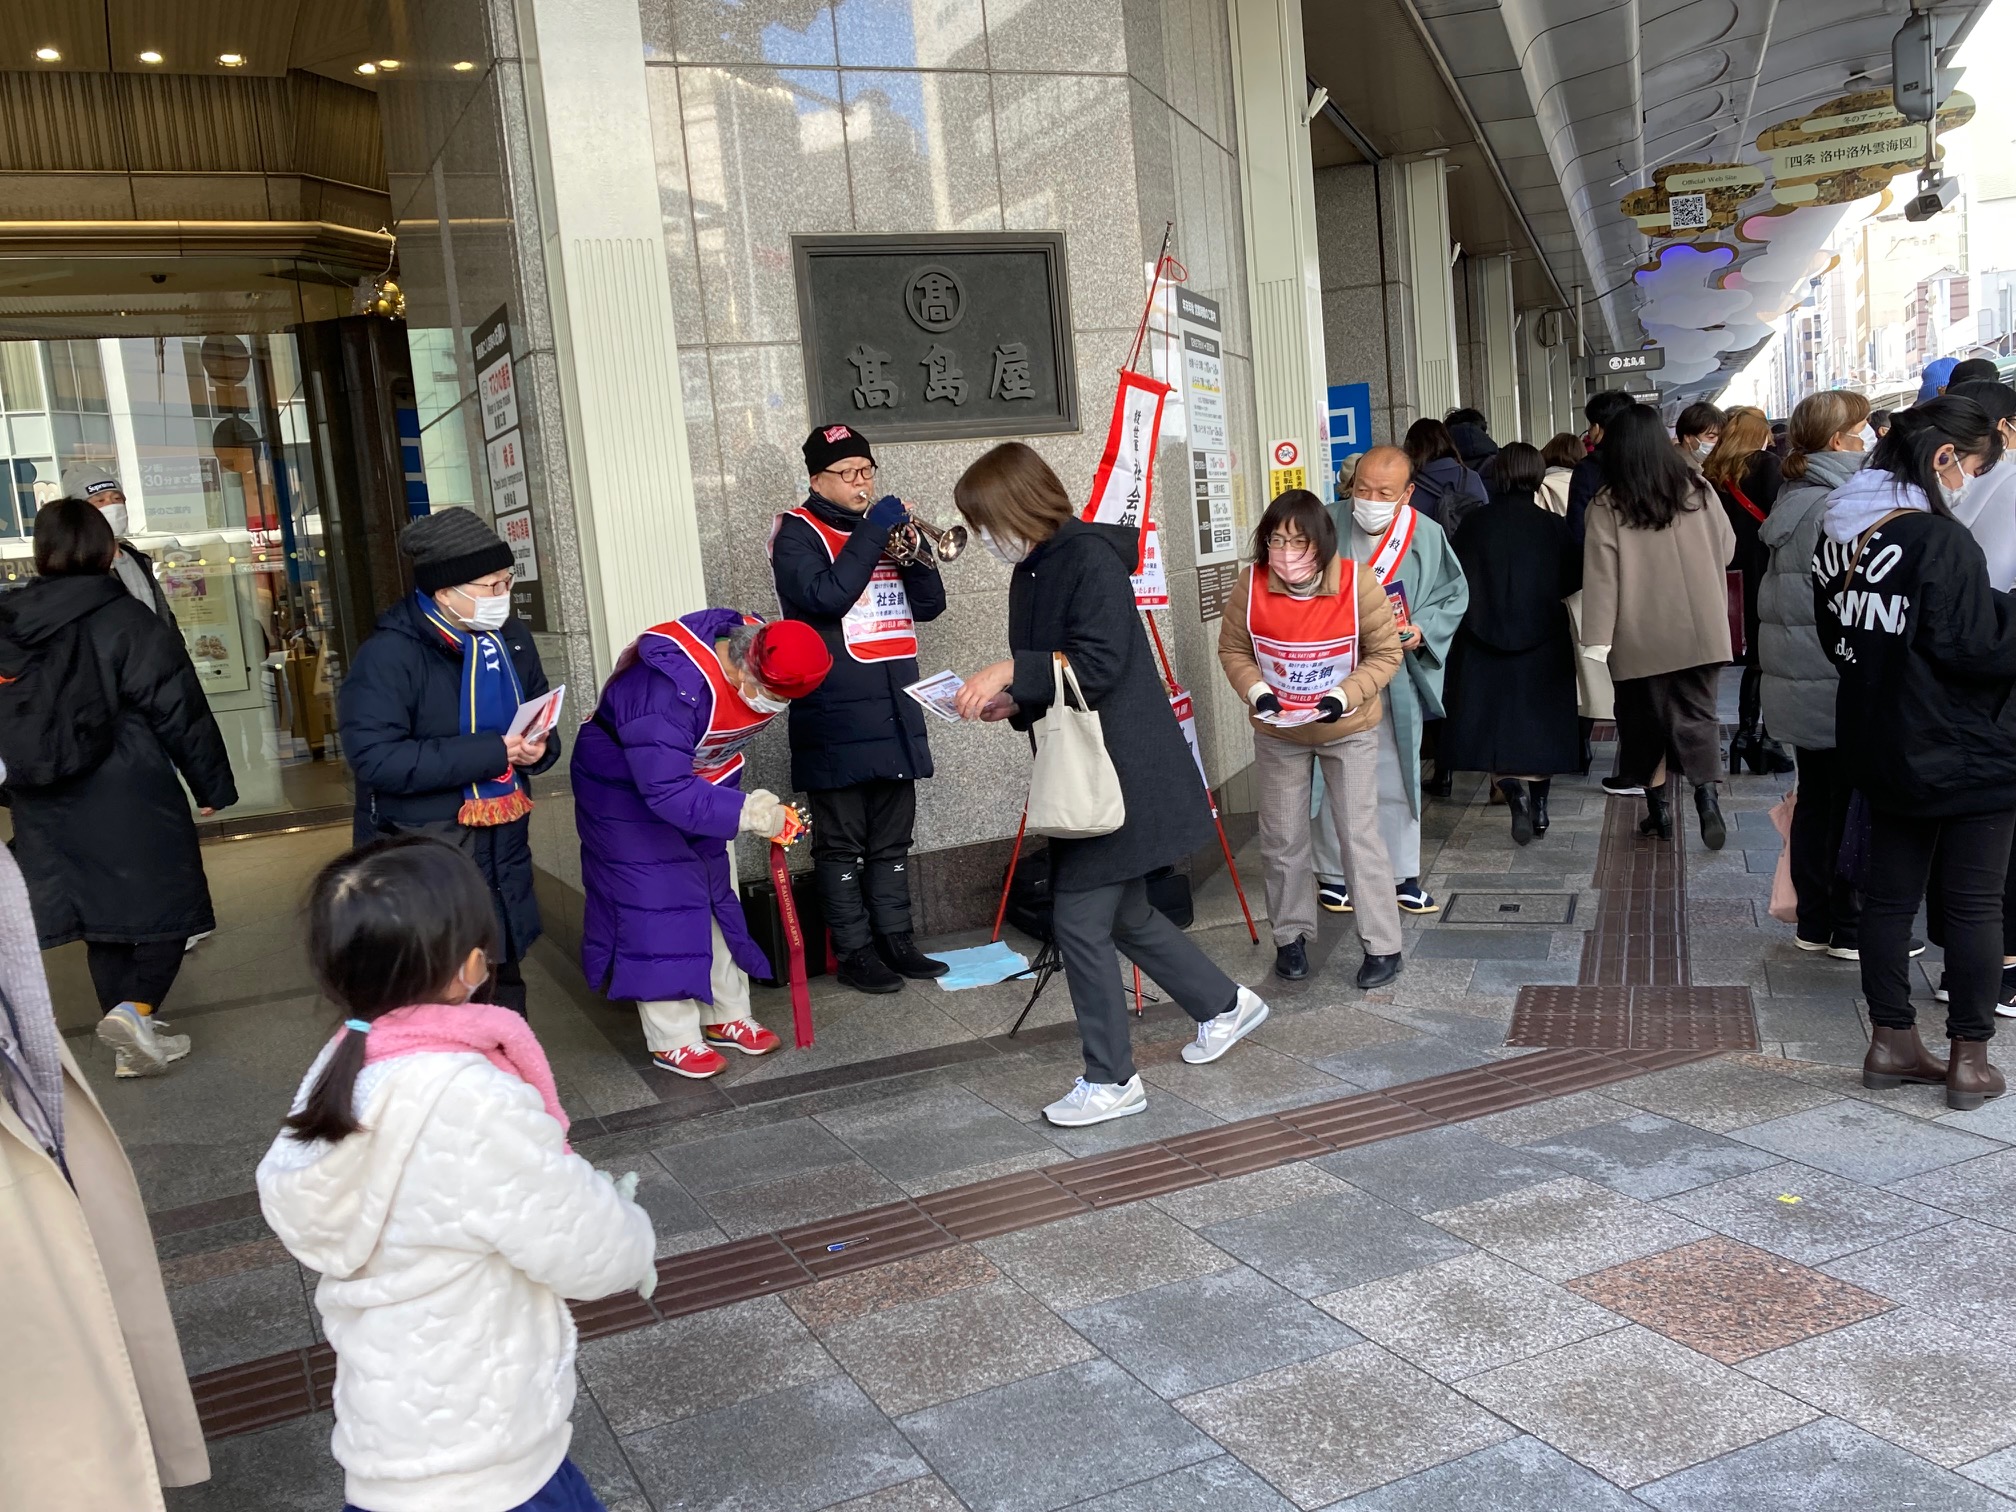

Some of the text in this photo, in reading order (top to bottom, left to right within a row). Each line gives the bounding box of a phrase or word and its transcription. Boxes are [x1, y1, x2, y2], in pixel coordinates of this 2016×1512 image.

[1682, 174, 1738, 186] Official Web Site
[1289, 665, 1335, 683] 社会鍋
[1290, 694, 1312, 702] SHIELD
[777, 868, 800, 947] THE SALVATION ARMY
